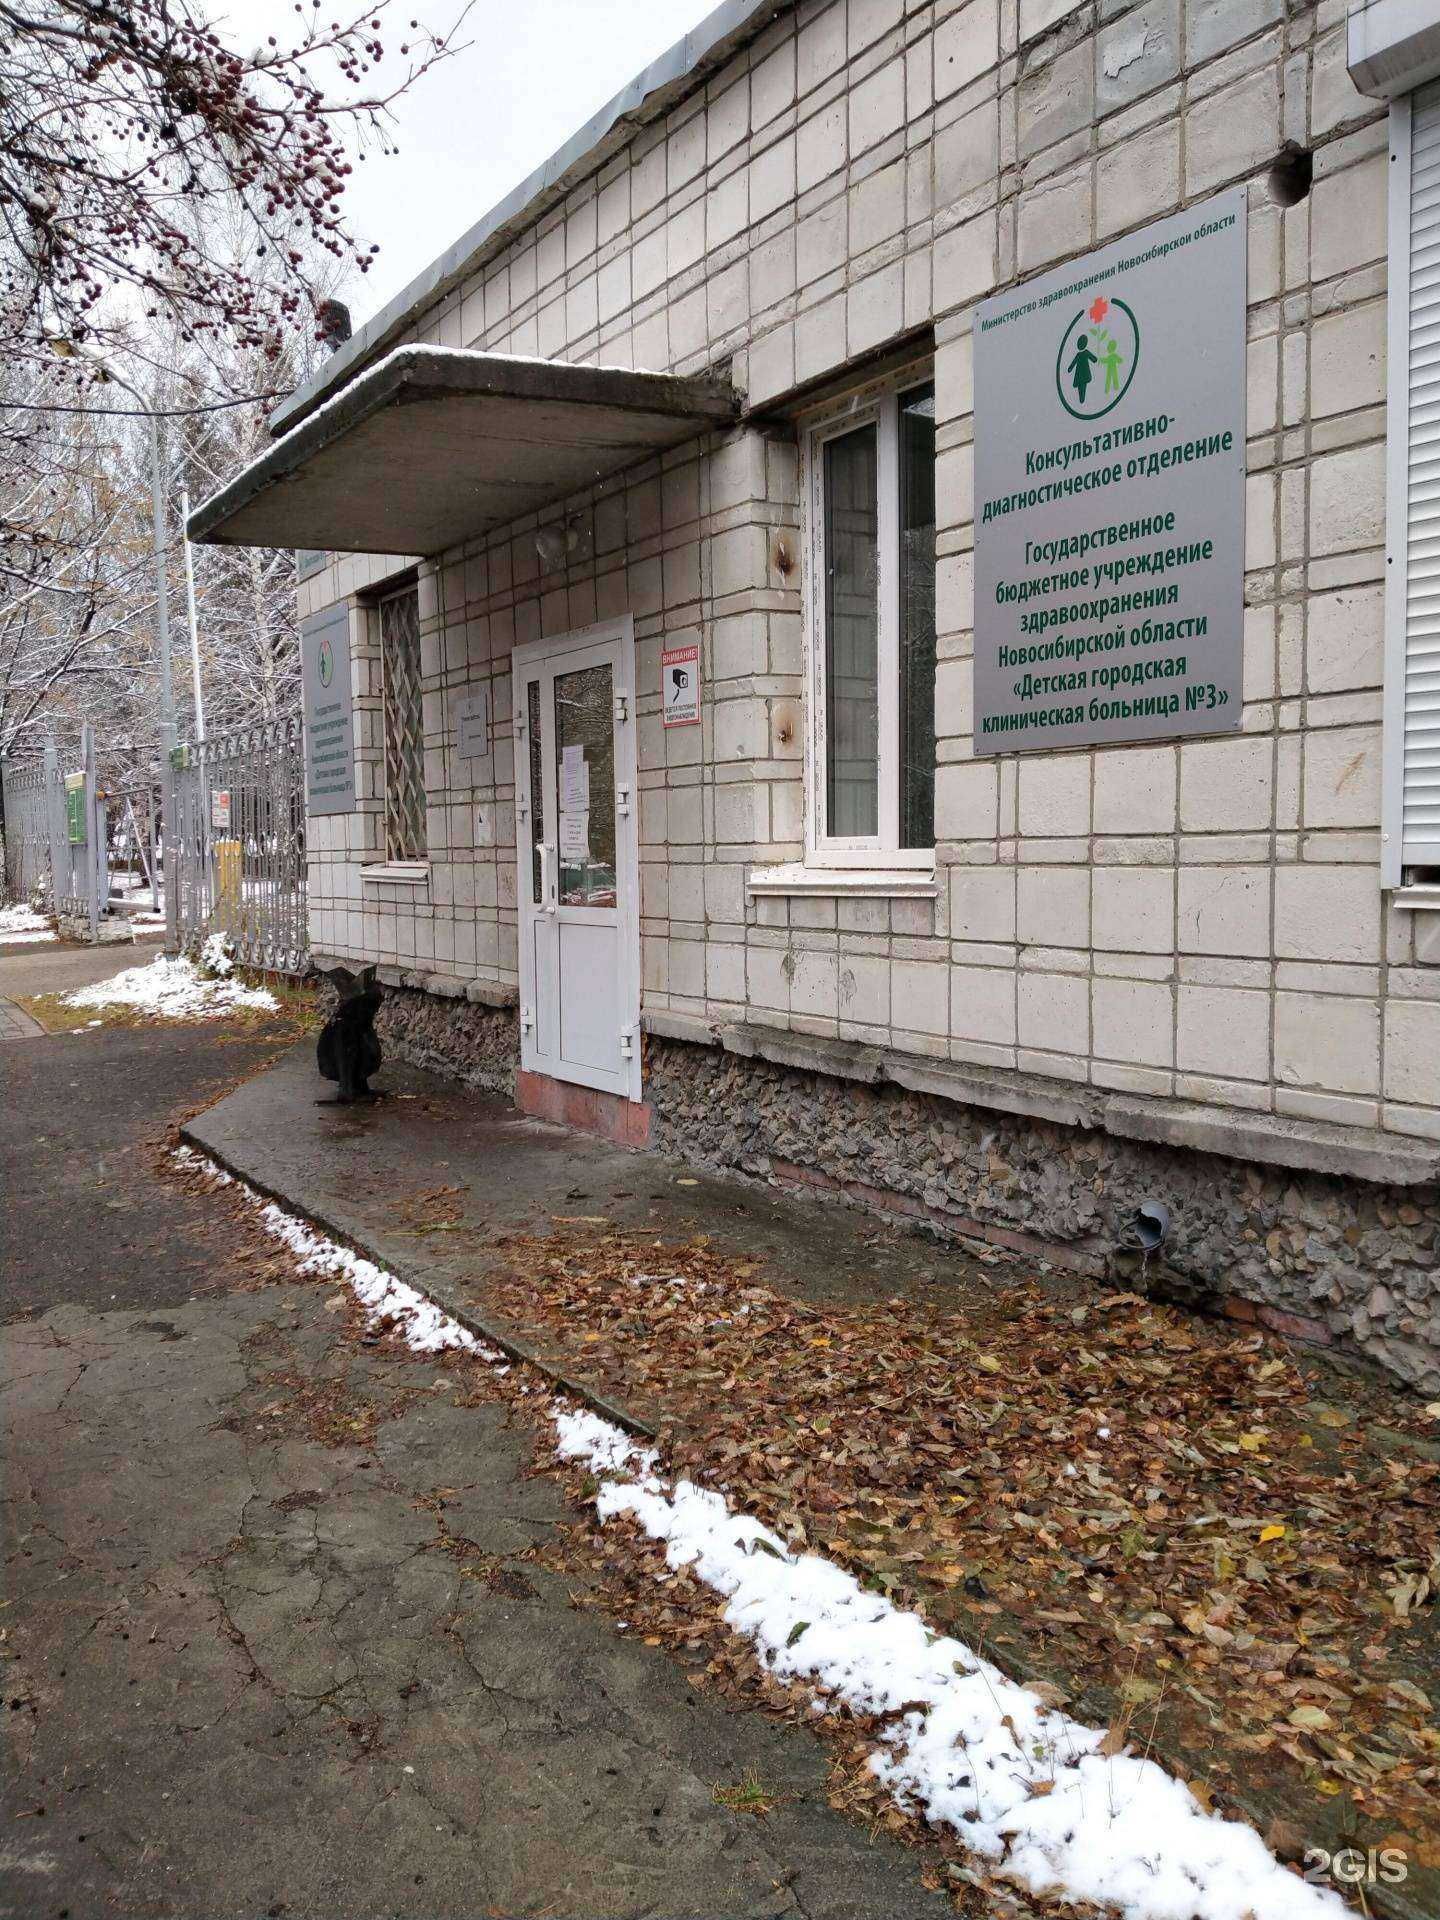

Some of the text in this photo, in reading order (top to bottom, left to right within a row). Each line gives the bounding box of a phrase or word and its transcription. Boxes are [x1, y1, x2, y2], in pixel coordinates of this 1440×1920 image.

[981, 301, 1037, 332] Министерство
[1038, 266, 1116, 308] здравоохранения
[1193, 213, 1236, 241] области
[1025, 414, 1176, 475] Консультативно-
[982, 430, 1233, 524] диагностическое отделение
[1025, 511, 1176, 564] Государственное
[995, 540, 1213, 604] бюджетное учреждение
[1020, 584, 1179, 633] здравоохранения
[998, 616, 1208, 668] Новосибирской области
[1013, 656, 1187, 701] «Детская городская
[982, 683, 1229, 733] клиническая больница №3»
